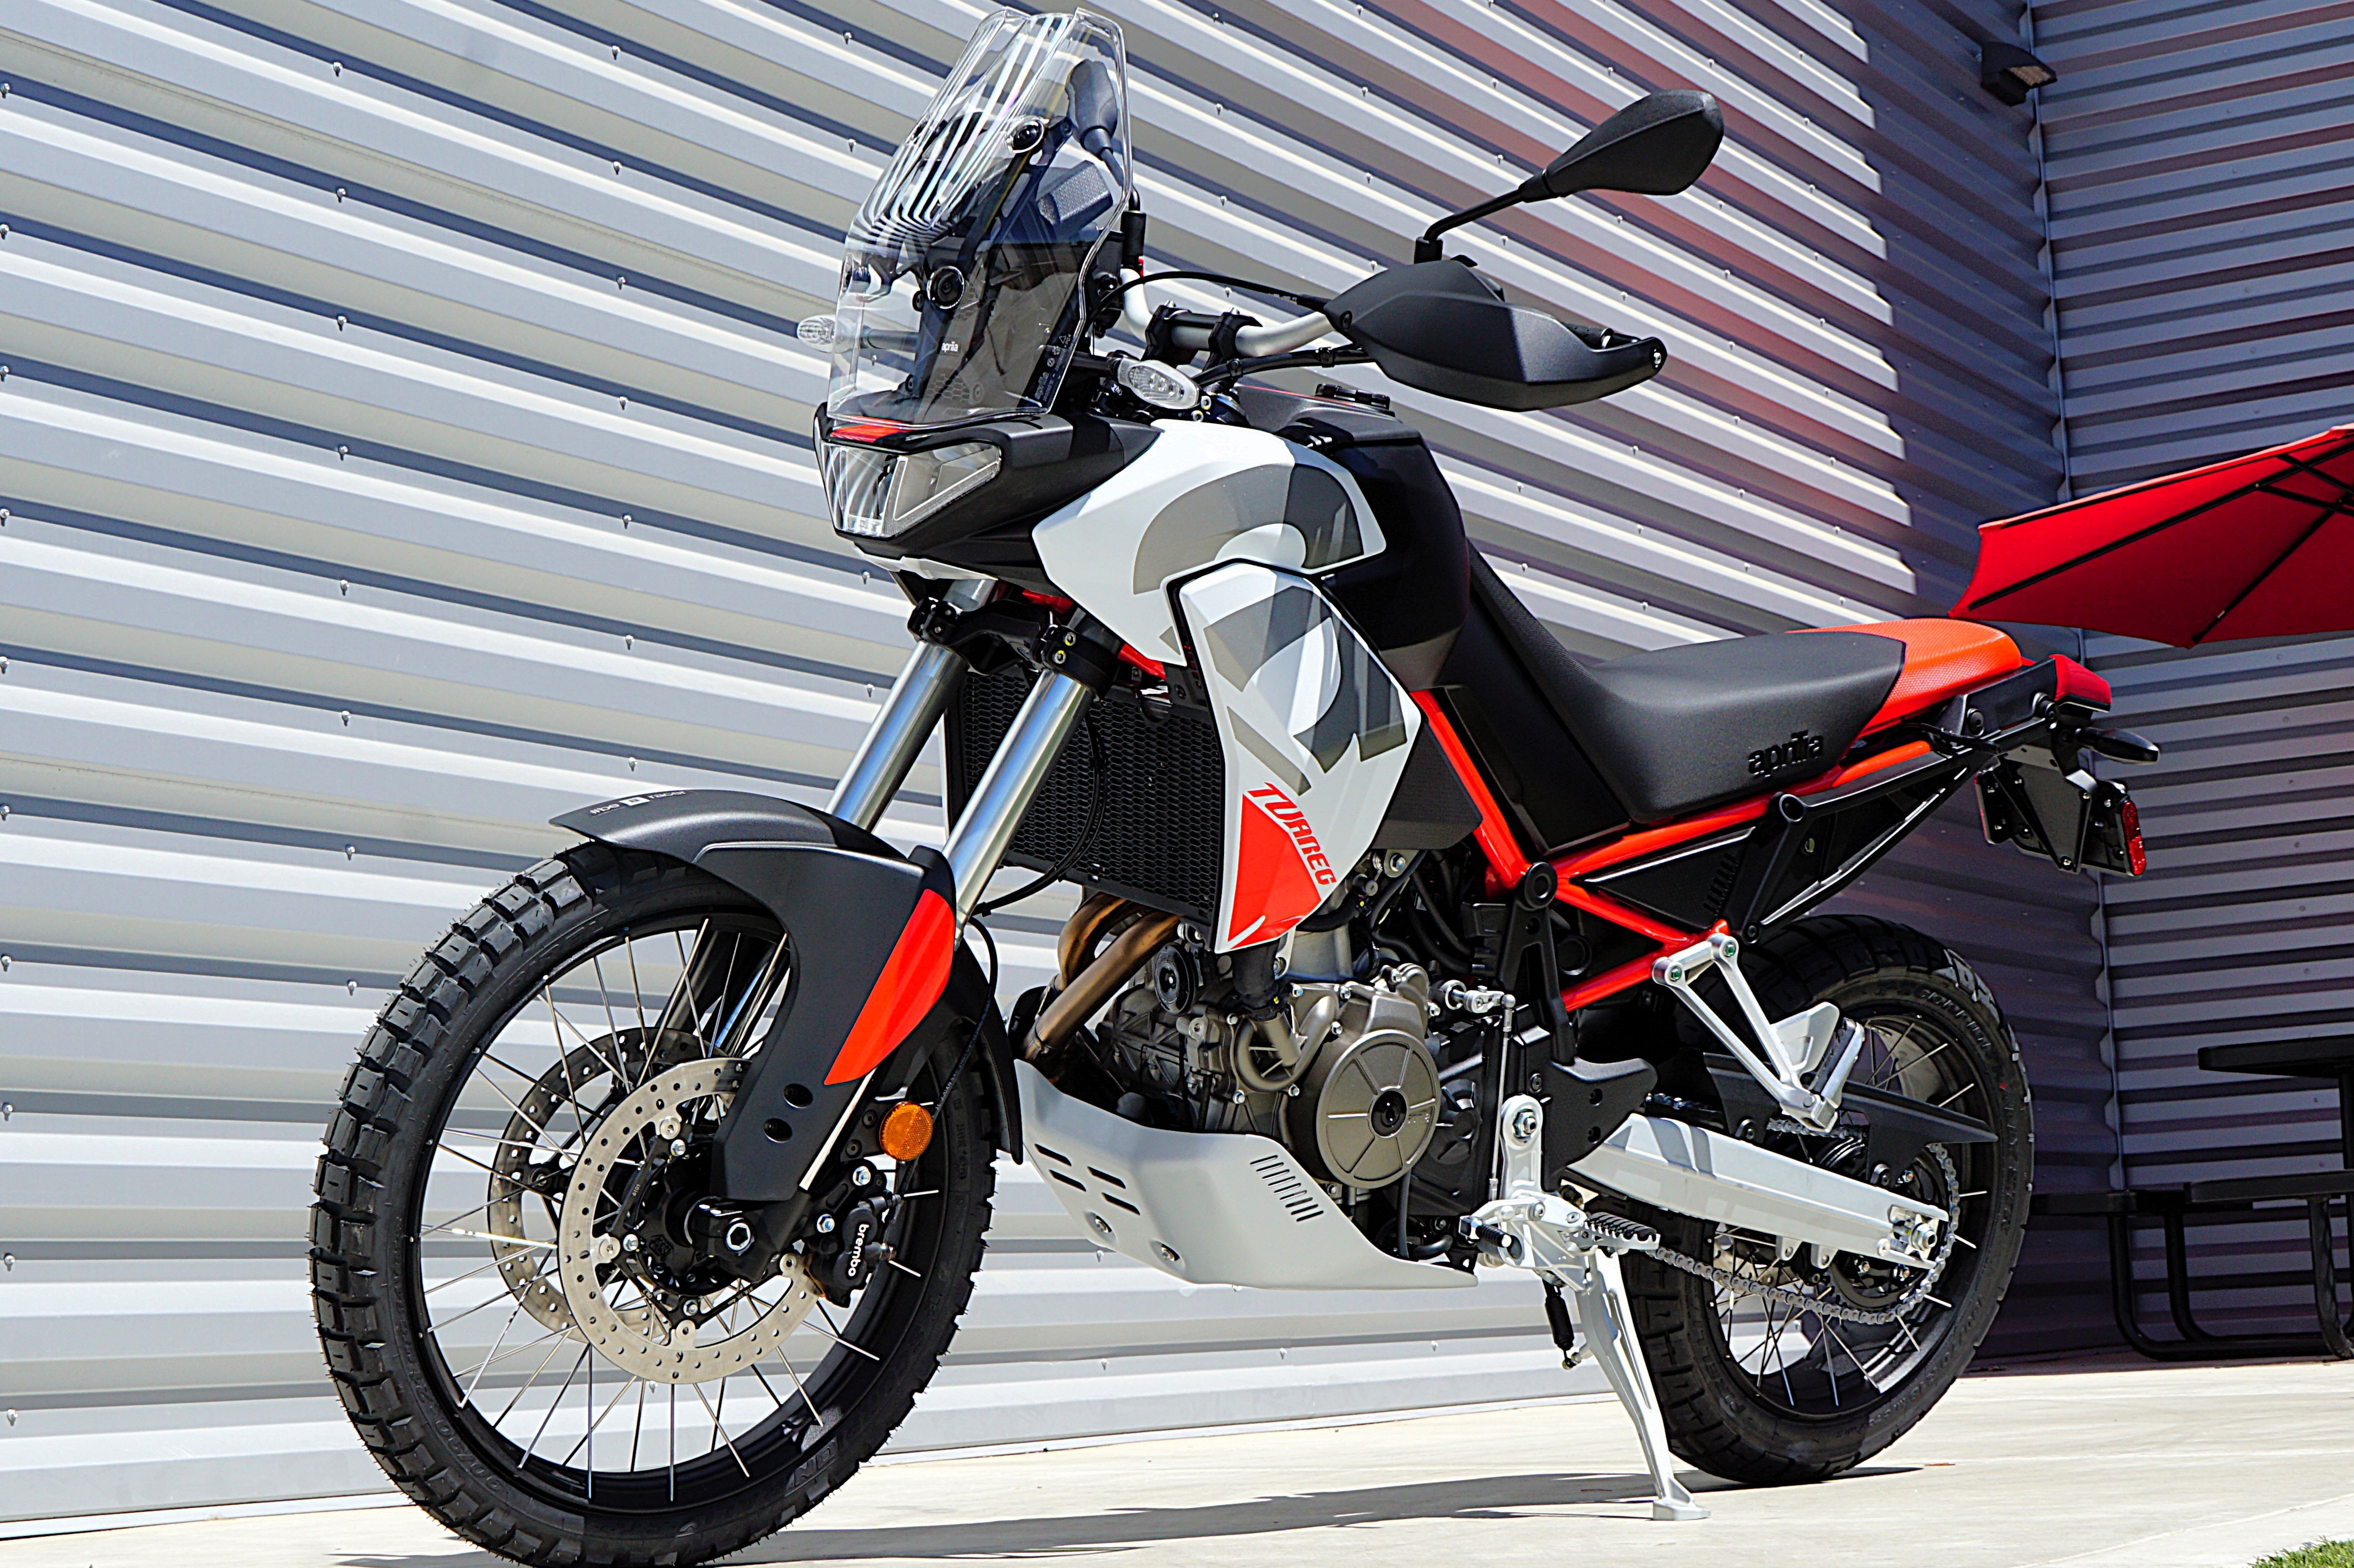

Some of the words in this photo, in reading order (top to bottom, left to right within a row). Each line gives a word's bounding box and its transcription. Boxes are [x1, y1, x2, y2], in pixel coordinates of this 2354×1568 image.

[941, 341, 958, 353] aprilia
[1748, 730, 1824, 777] aprilia
[1247, 782, 1338, 886] TUAREG
[848, 1223, 869, 1277] brembo
